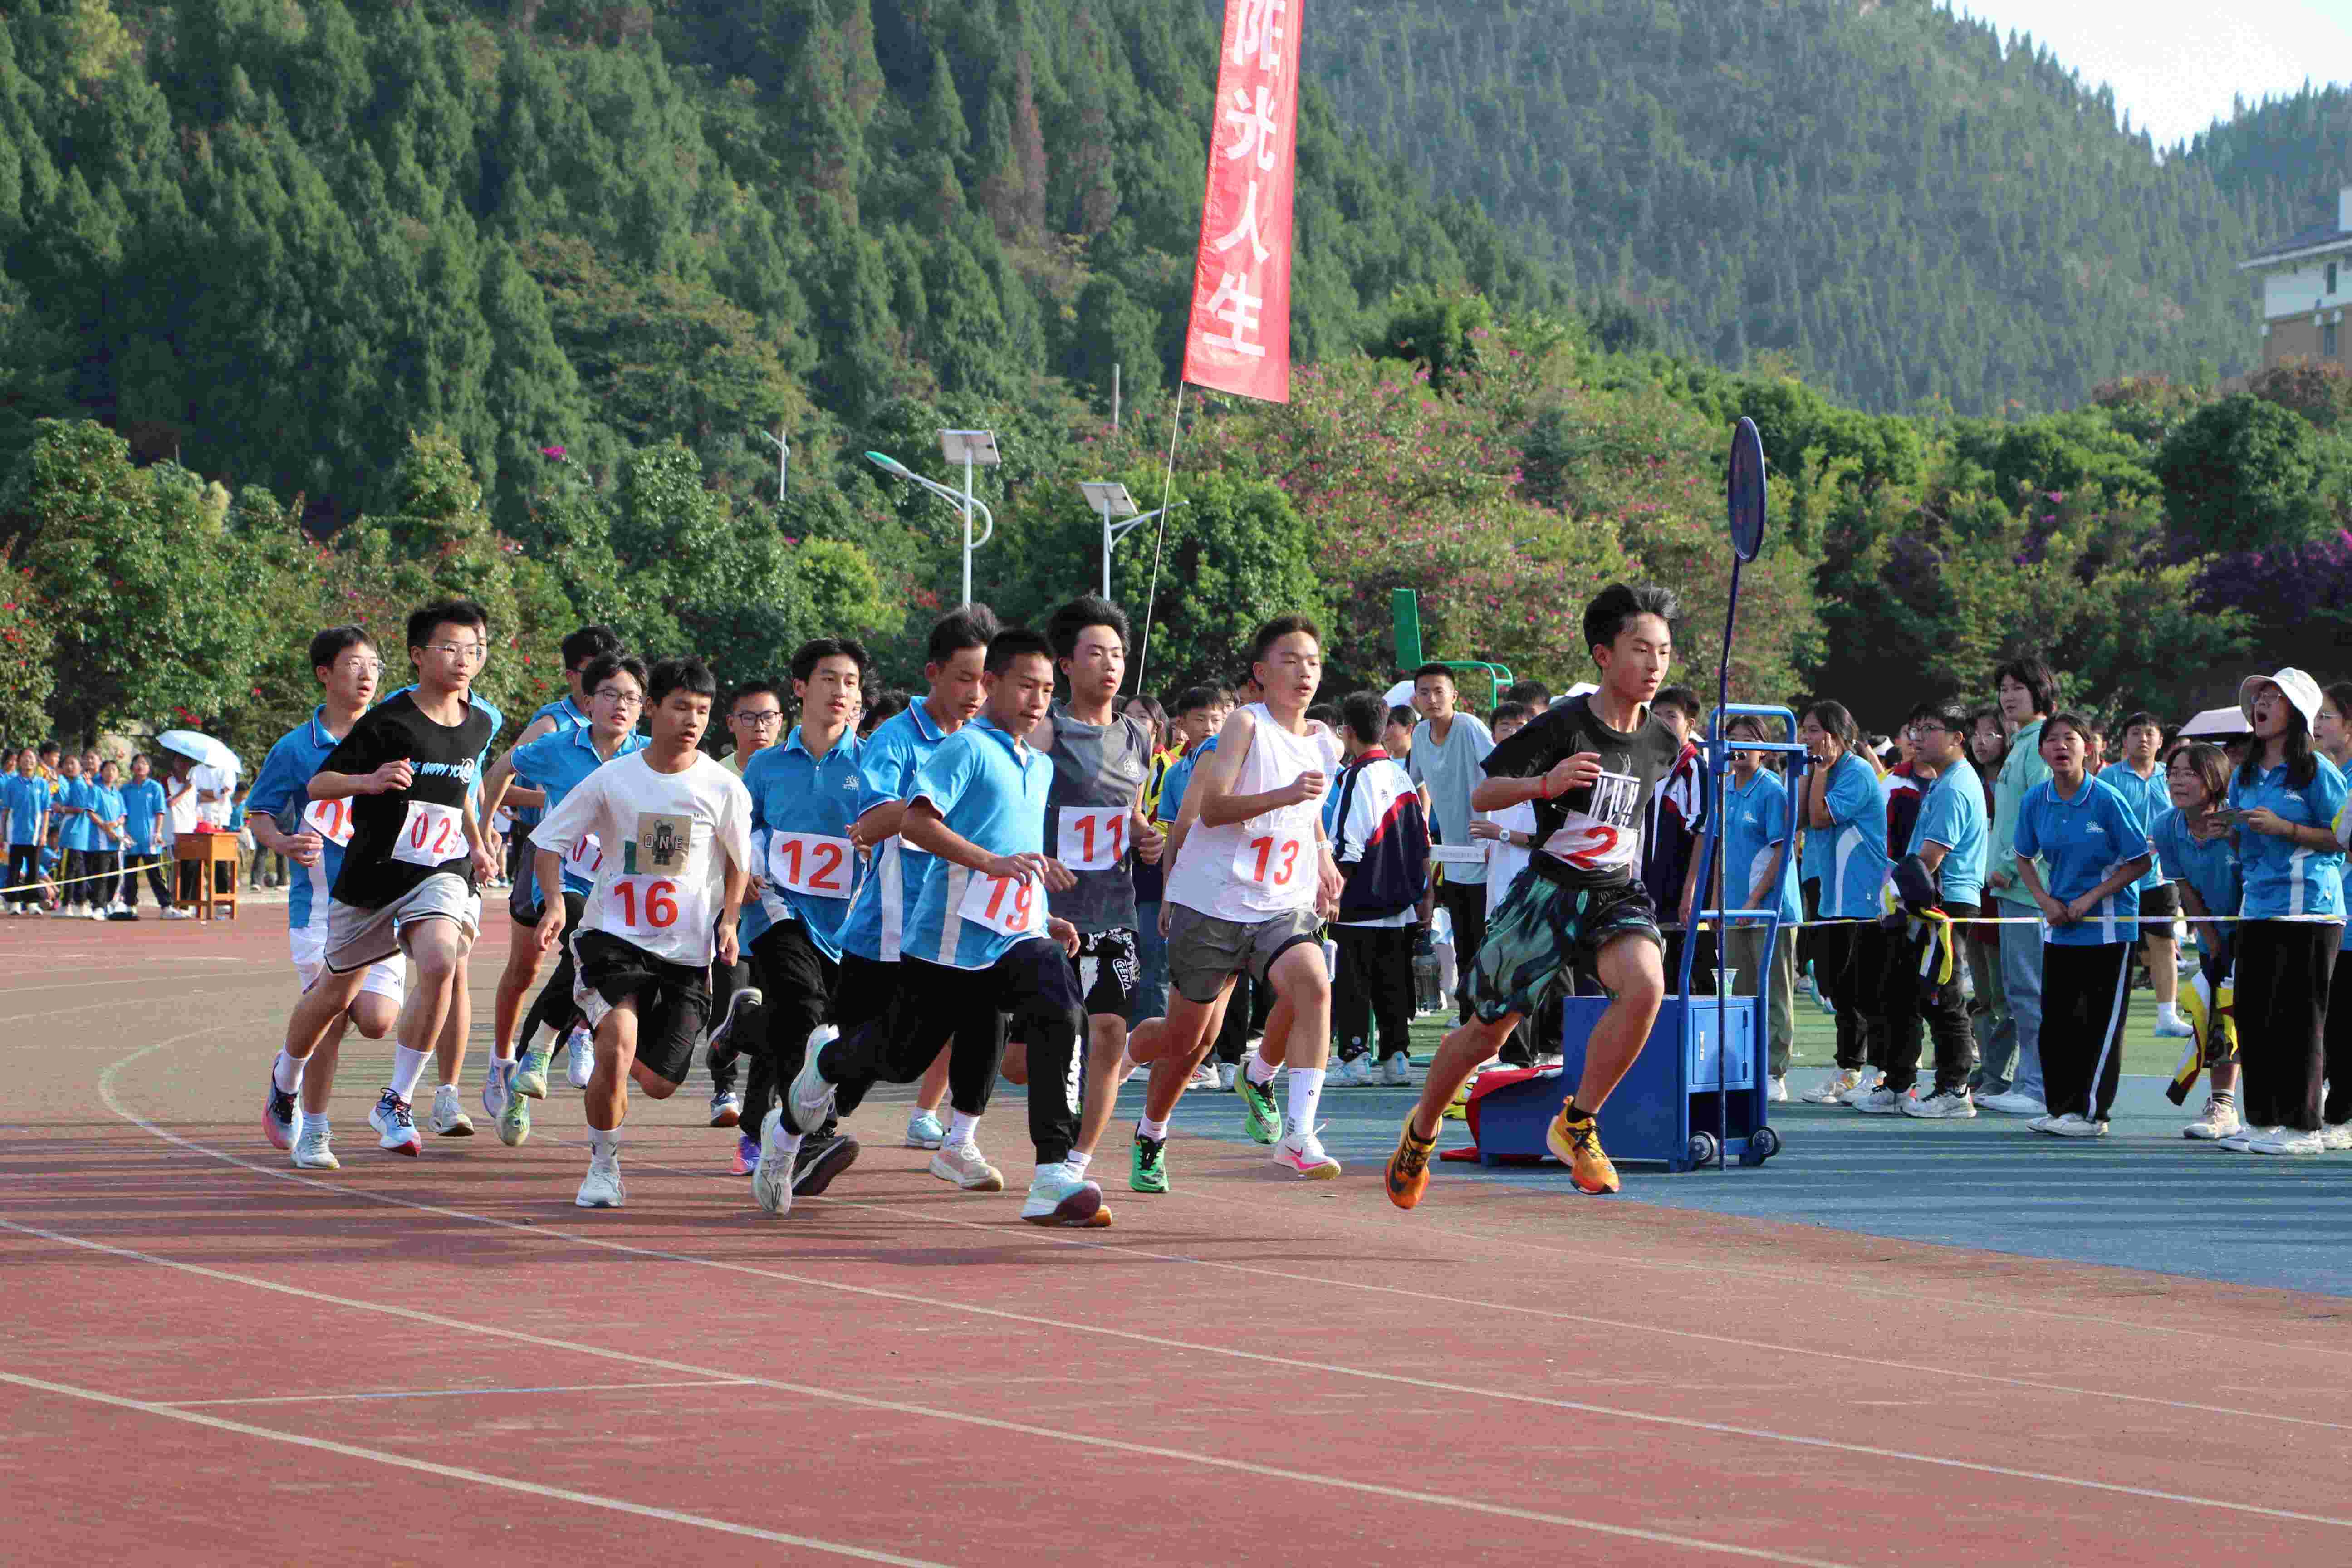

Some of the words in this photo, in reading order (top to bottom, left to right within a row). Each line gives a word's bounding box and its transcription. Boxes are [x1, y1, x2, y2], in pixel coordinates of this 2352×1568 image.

[1202, 0, 1285, 357] 阳光人生
[421, 762, 450, 776] HAPPY
[644, 834, 683, 850] ONE
[1074, 815, 1123, 862] 11
[1250, 836, 1300, 886] 13
[1563, 826, 1618, 869] 2
[781, 839, 843, 890] 12
[614, 881, 678, 928] 16
[984, 876, 1032, 931] 19
